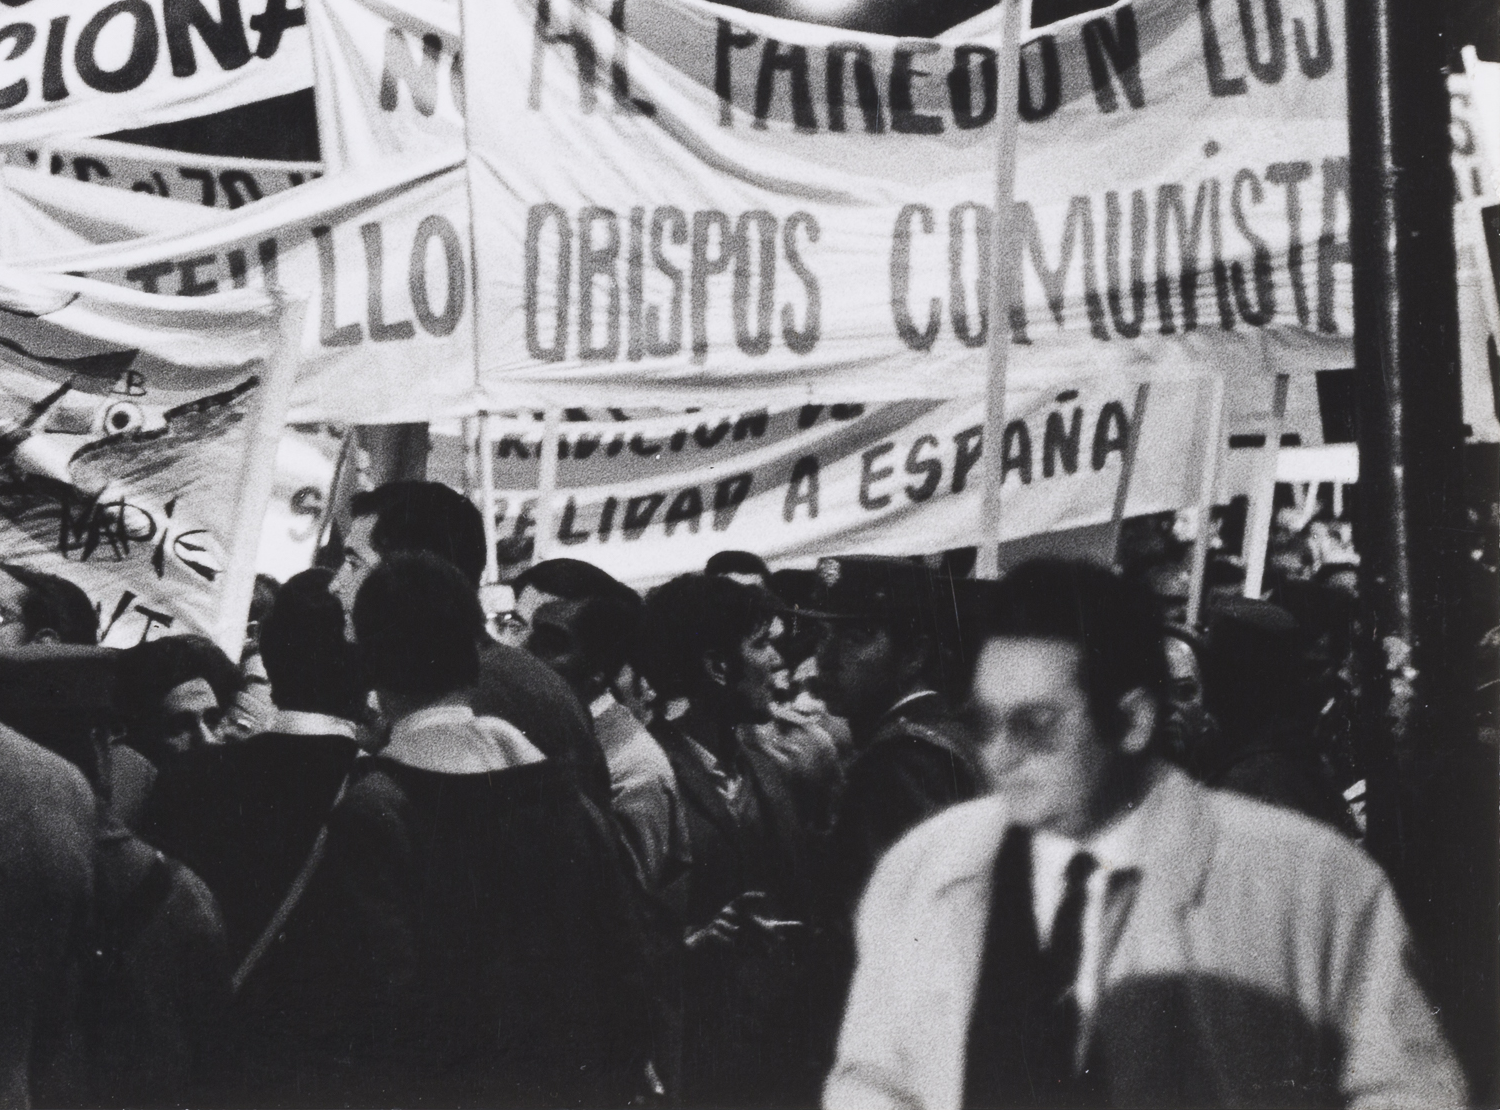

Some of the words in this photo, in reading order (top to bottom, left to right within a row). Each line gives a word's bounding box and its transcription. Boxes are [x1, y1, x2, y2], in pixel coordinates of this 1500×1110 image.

[525, 201, 823, 366] OBISPOS
[782, 455, 819, 523] A
[858, 389, 1132, 511] ESPAÑA
